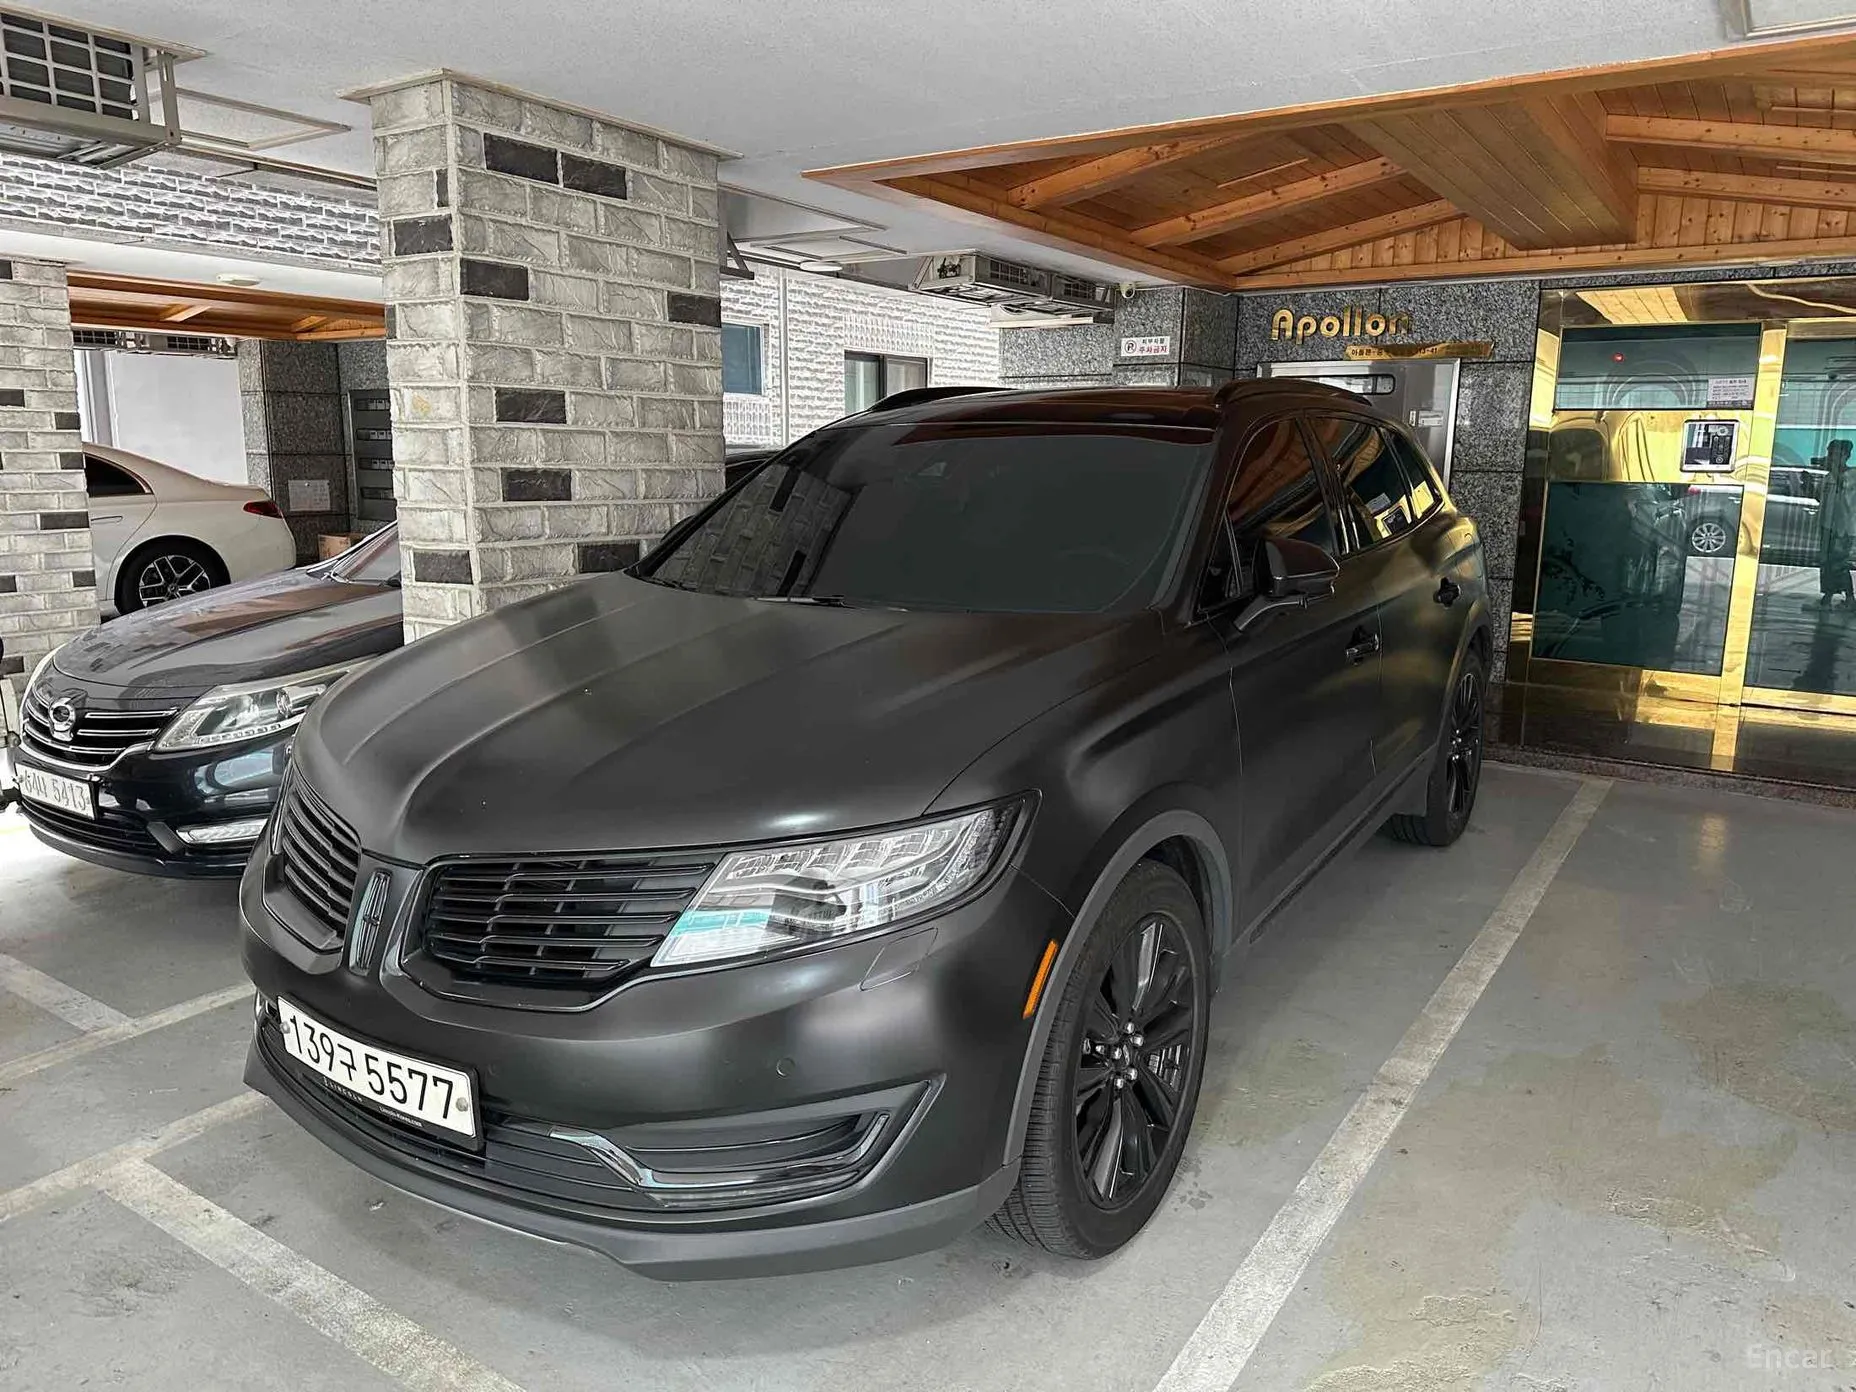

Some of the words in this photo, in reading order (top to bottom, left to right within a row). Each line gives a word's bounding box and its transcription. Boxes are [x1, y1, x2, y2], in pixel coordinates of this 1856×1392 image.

[1271, 305, 1412, 345] Apollon
[1139, 345, 1168, 354] 주차금지
[52, 778, 87, 811] 5413
[290, 1015, 357, 1082] 139구
[364, 1052, 454, 1120] 5577
